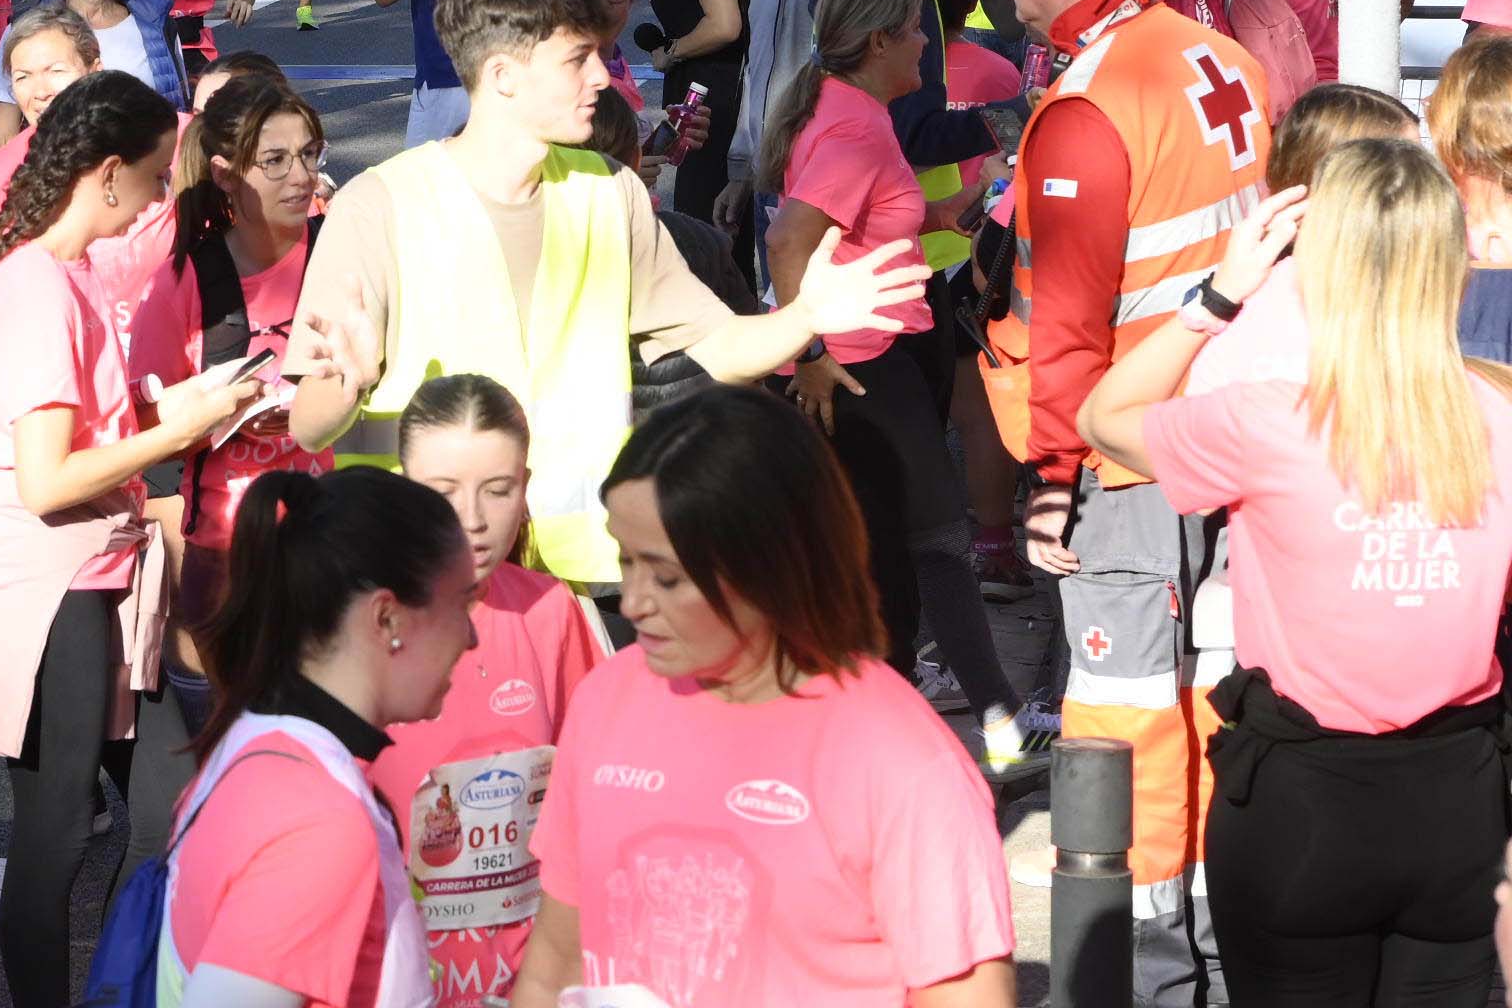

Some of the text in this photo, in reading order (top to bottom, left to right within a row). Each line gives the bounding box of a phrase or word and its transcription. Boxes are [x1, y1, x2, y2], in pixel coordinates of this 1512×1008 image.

[1363, 529, 1455, 561] DE LA
[1351, 560, 1461, 591] MUJER
[465, 784, 522, 803] ASTURIANA
[468, 820, 519, 849] 016
[473, 853, 514, 871] 19621
[426, 880, 474, 893] CARRERA
[476, 878, 489, 889] DE
[490, 875, 504, 886] LA
